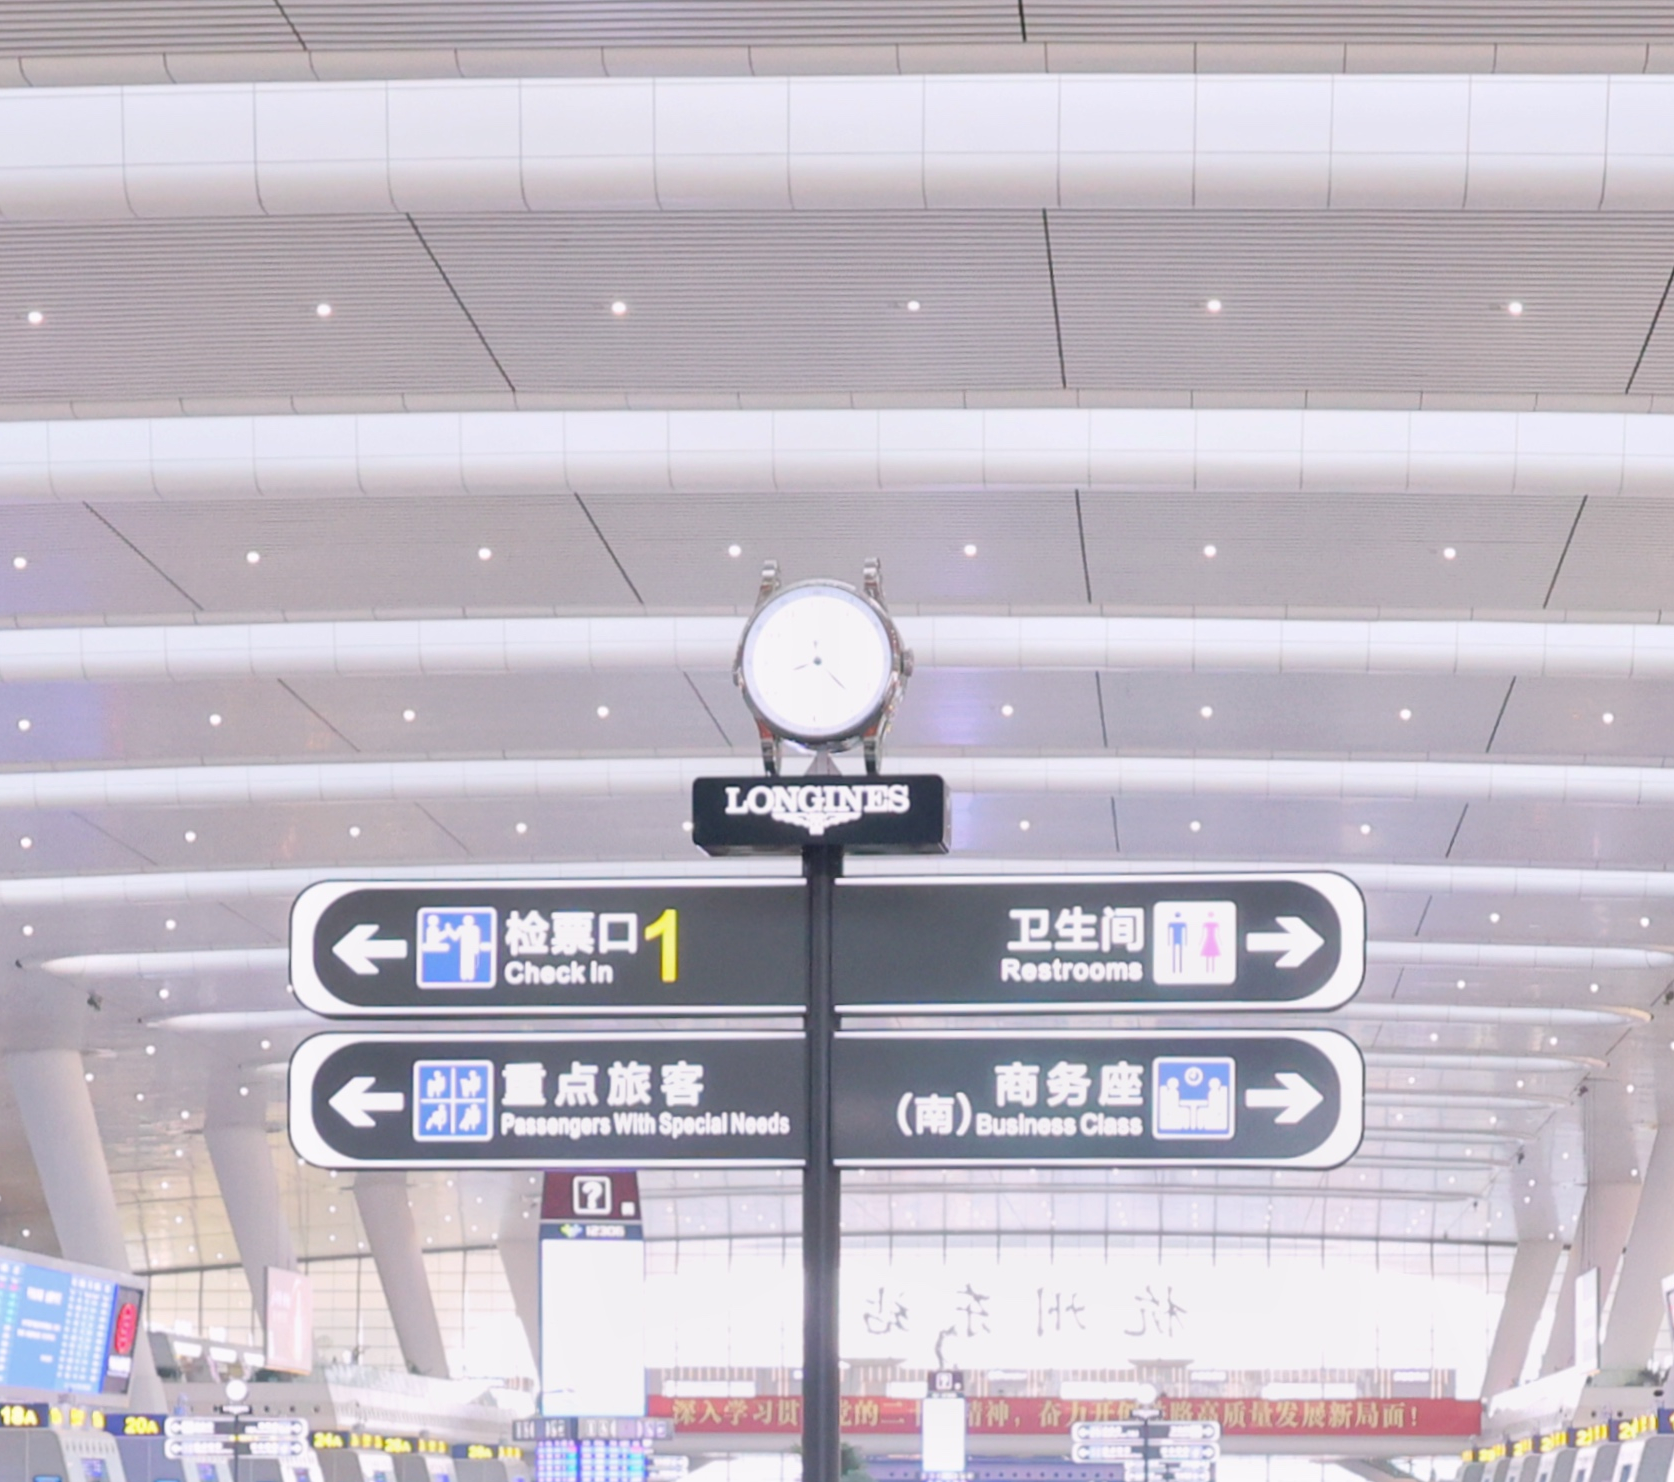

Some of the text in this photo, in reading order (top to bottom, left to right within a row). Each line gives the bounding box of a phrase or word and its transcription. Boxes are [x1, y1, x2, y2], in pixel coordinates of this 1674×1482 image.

[725, 784, 910, 813] LONGINES
[505, 909, 638, 957] 检票口
[1007, 906, 1145, 954] 卫生间
[644, 908, 677, 982] 1
[504, 961, 587, 985] Check
[1001, 958, 1144, 982] Restrooms
[502, 1062, 704, 1106] 重点旅客
[994, 1060, 1144, 1109] 商务座
[500, 1112, 791, 1140] Passengers With Special Needs
[975, 1112, 1144, 1136] Business Class
[124, 1415, 160, 1436] 20A
